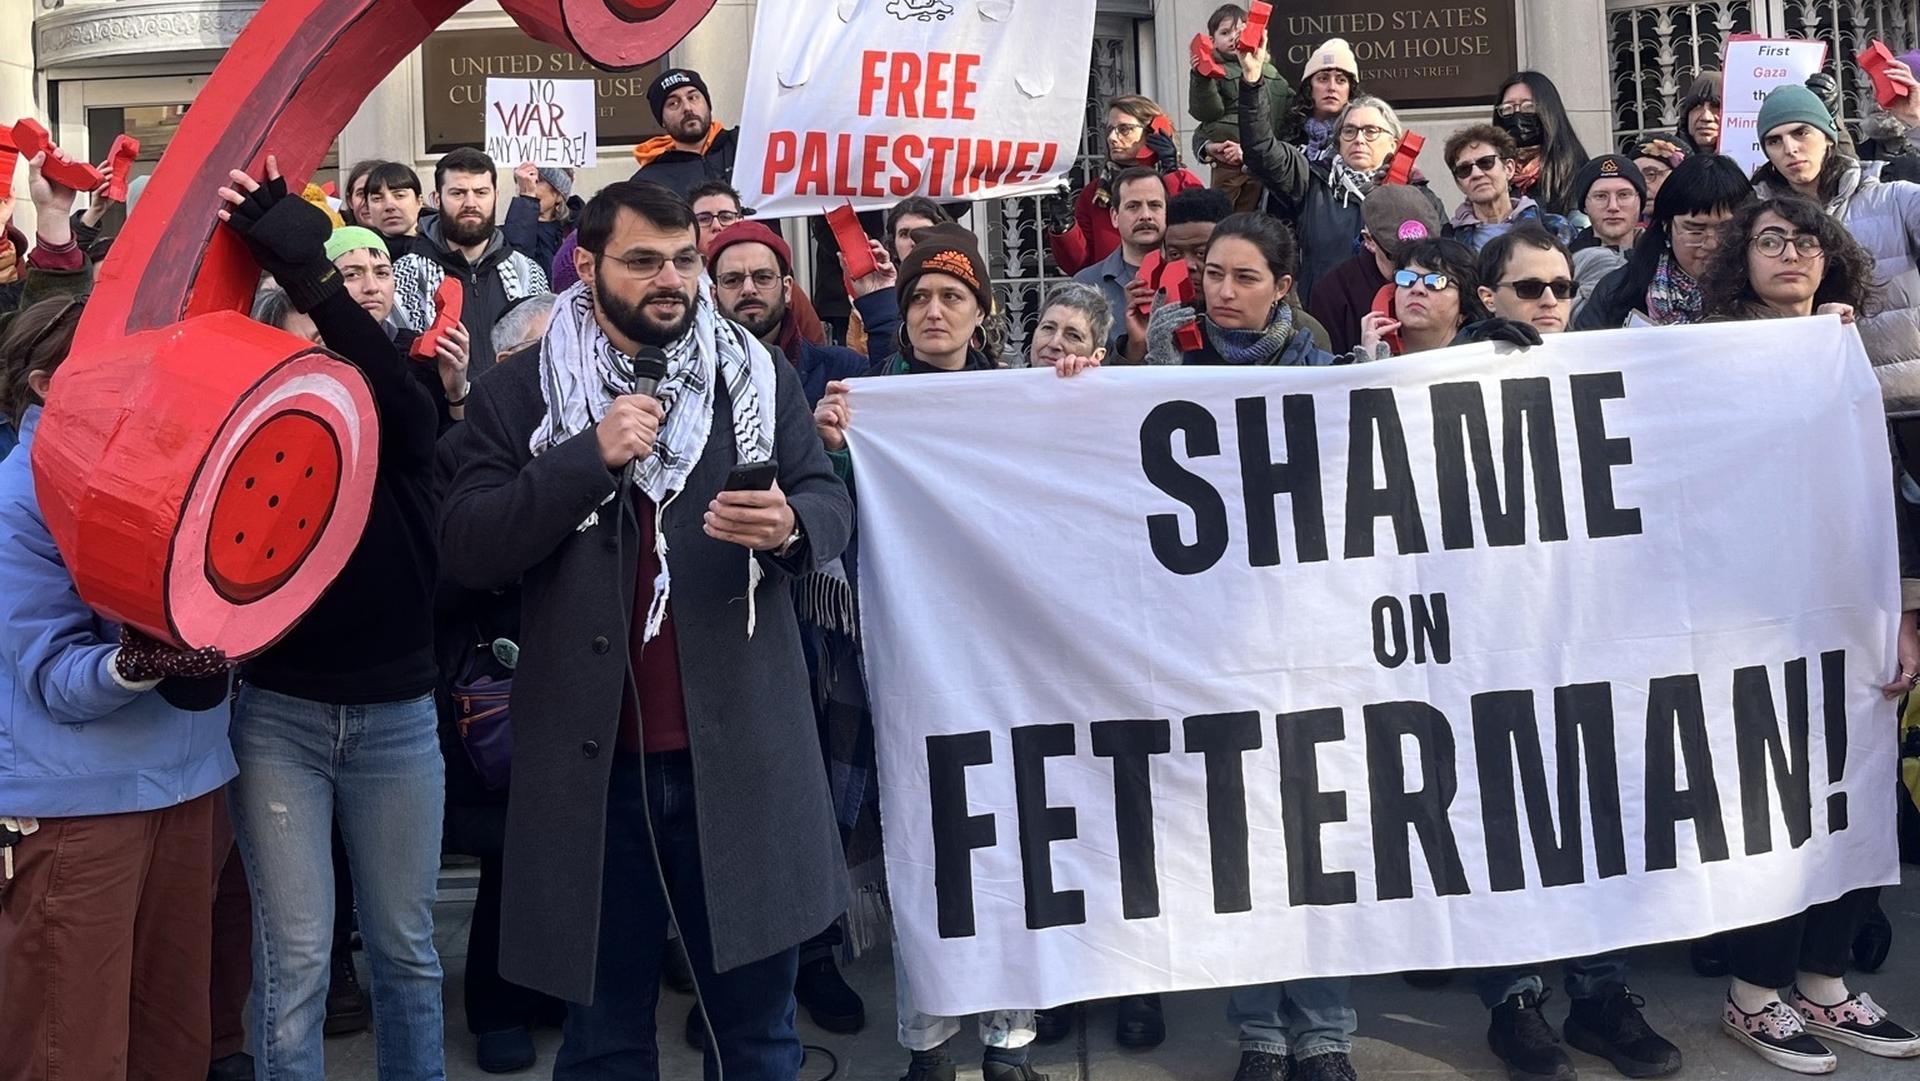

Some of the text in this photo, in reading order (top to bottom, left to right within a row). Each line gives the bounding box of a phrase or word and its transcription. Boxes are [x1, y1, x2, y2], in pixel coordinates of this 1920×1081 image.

[1288, 7, 1487, 36] UNITED STATES
[1288, 36, 1491, 64] COM HOUSE
[1758, 45, 1790, 56] First
[450, 53, 594, 77] UNITED STA
[1359, 65, 1460, 80] ESTNUT STREET
[1753, 66, 1787, 78] Gaza
[529, 79, 555, 105] NO
[597, 77, 644, 97] USE
[858, 50, 980, 120] FREE
[493, 101, 566, 137] WAR
[486, 131, 588, 168] ANYWHERE!
[761, 131, 1058, 197] PALESTINE!
[1140, 372, 1642, 575] SHAME
[1372, 593, 1451, 668] ON
[926, 650, 1849, 938] FETTERMAN!
